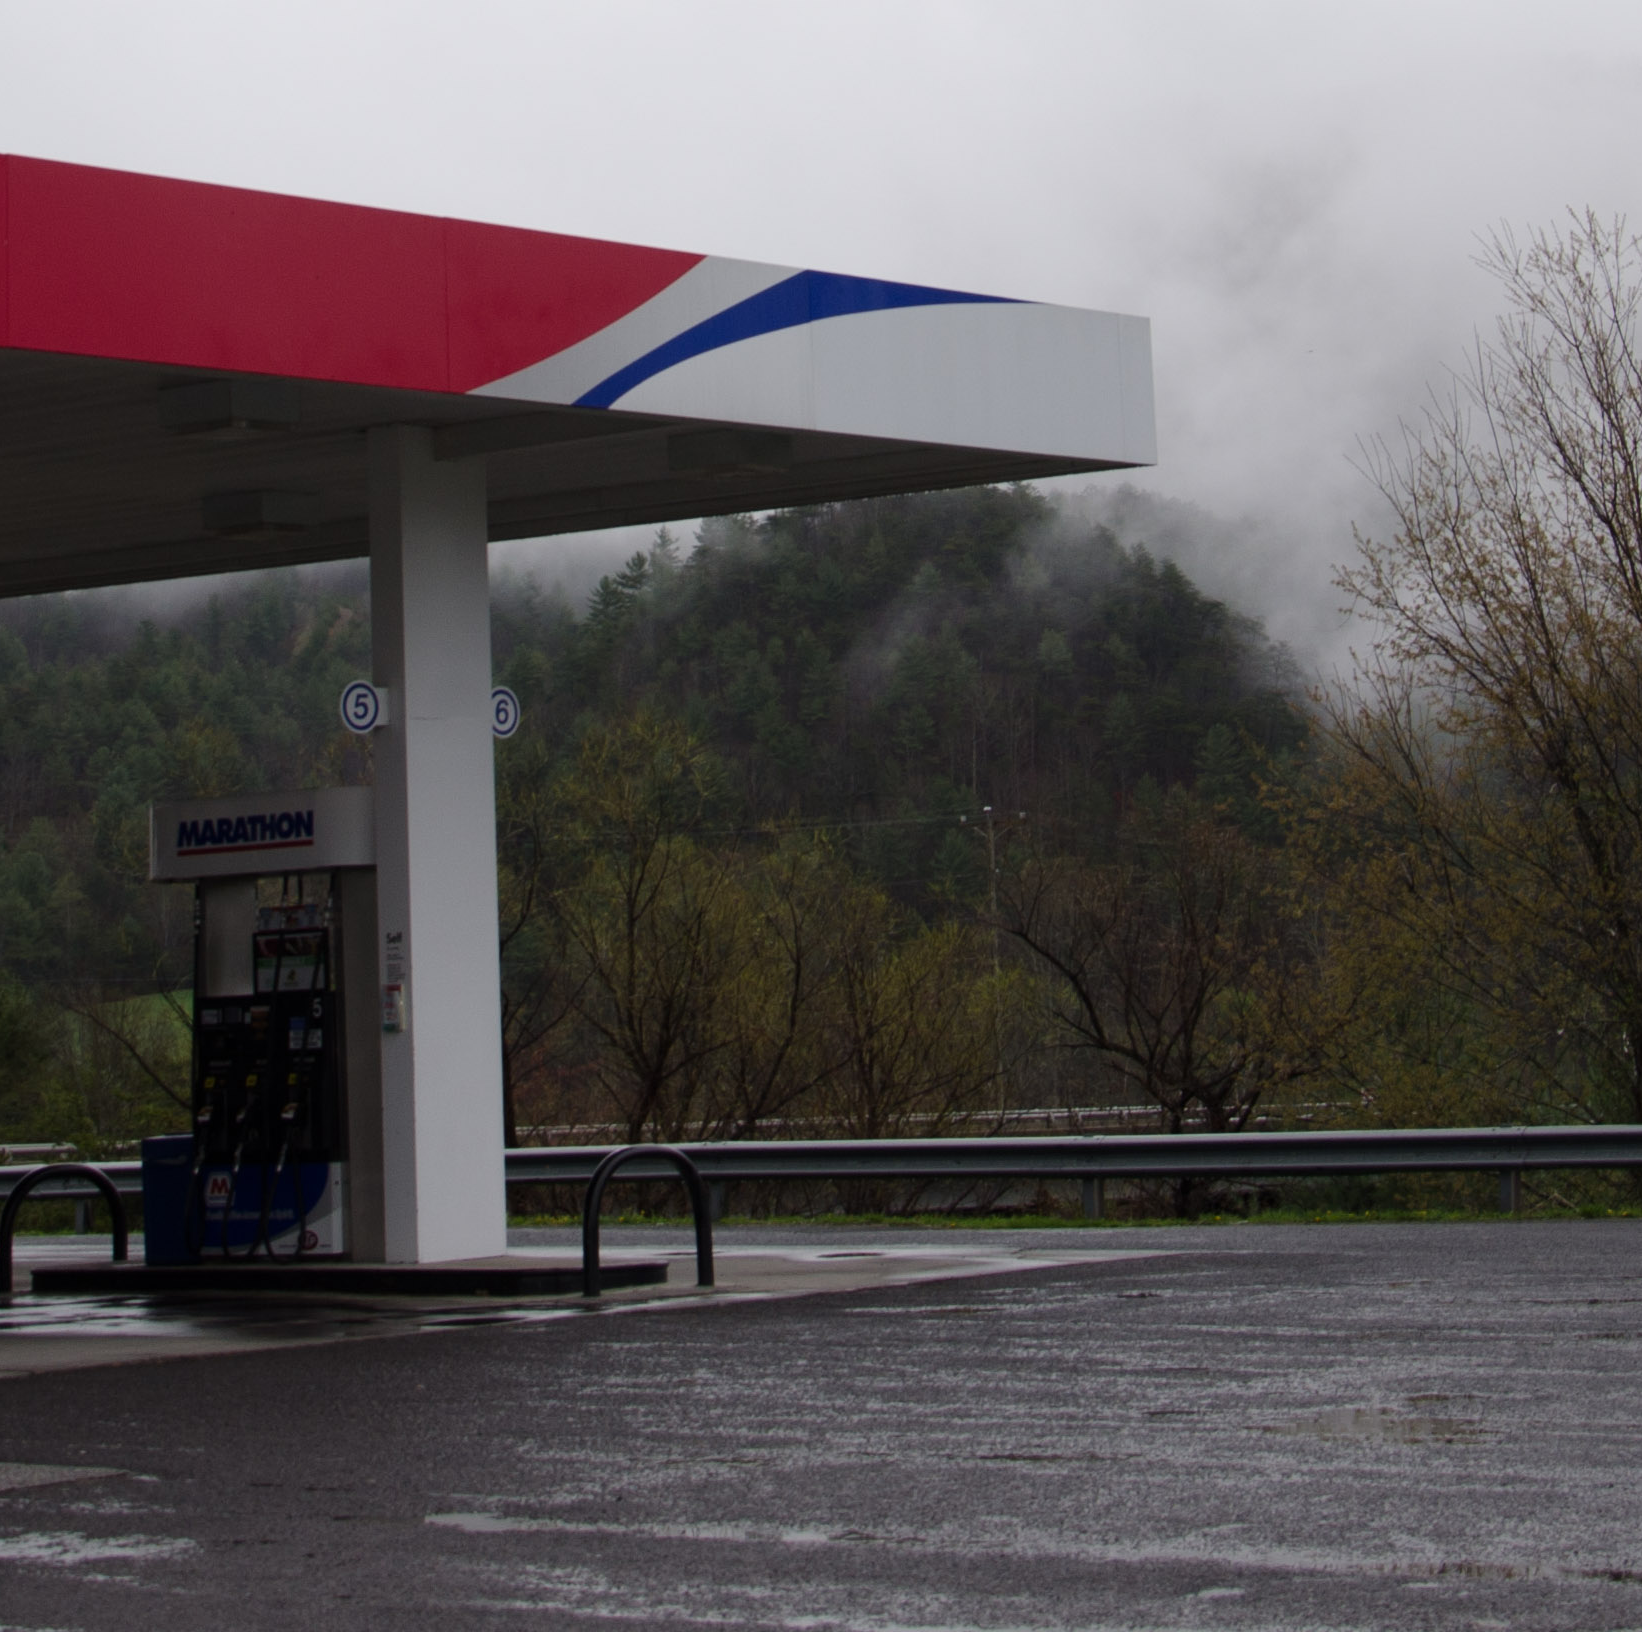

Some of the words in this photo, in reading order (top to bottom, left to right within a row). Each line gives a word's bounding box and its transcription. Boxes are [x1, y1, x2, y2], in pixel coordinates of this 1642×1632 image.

[354, 693, 368, 720] 5
[495, 699, 509, 724] 6
[177, 809, 314, 848] MARATHON
[312, 997, 323, 1018] 5
